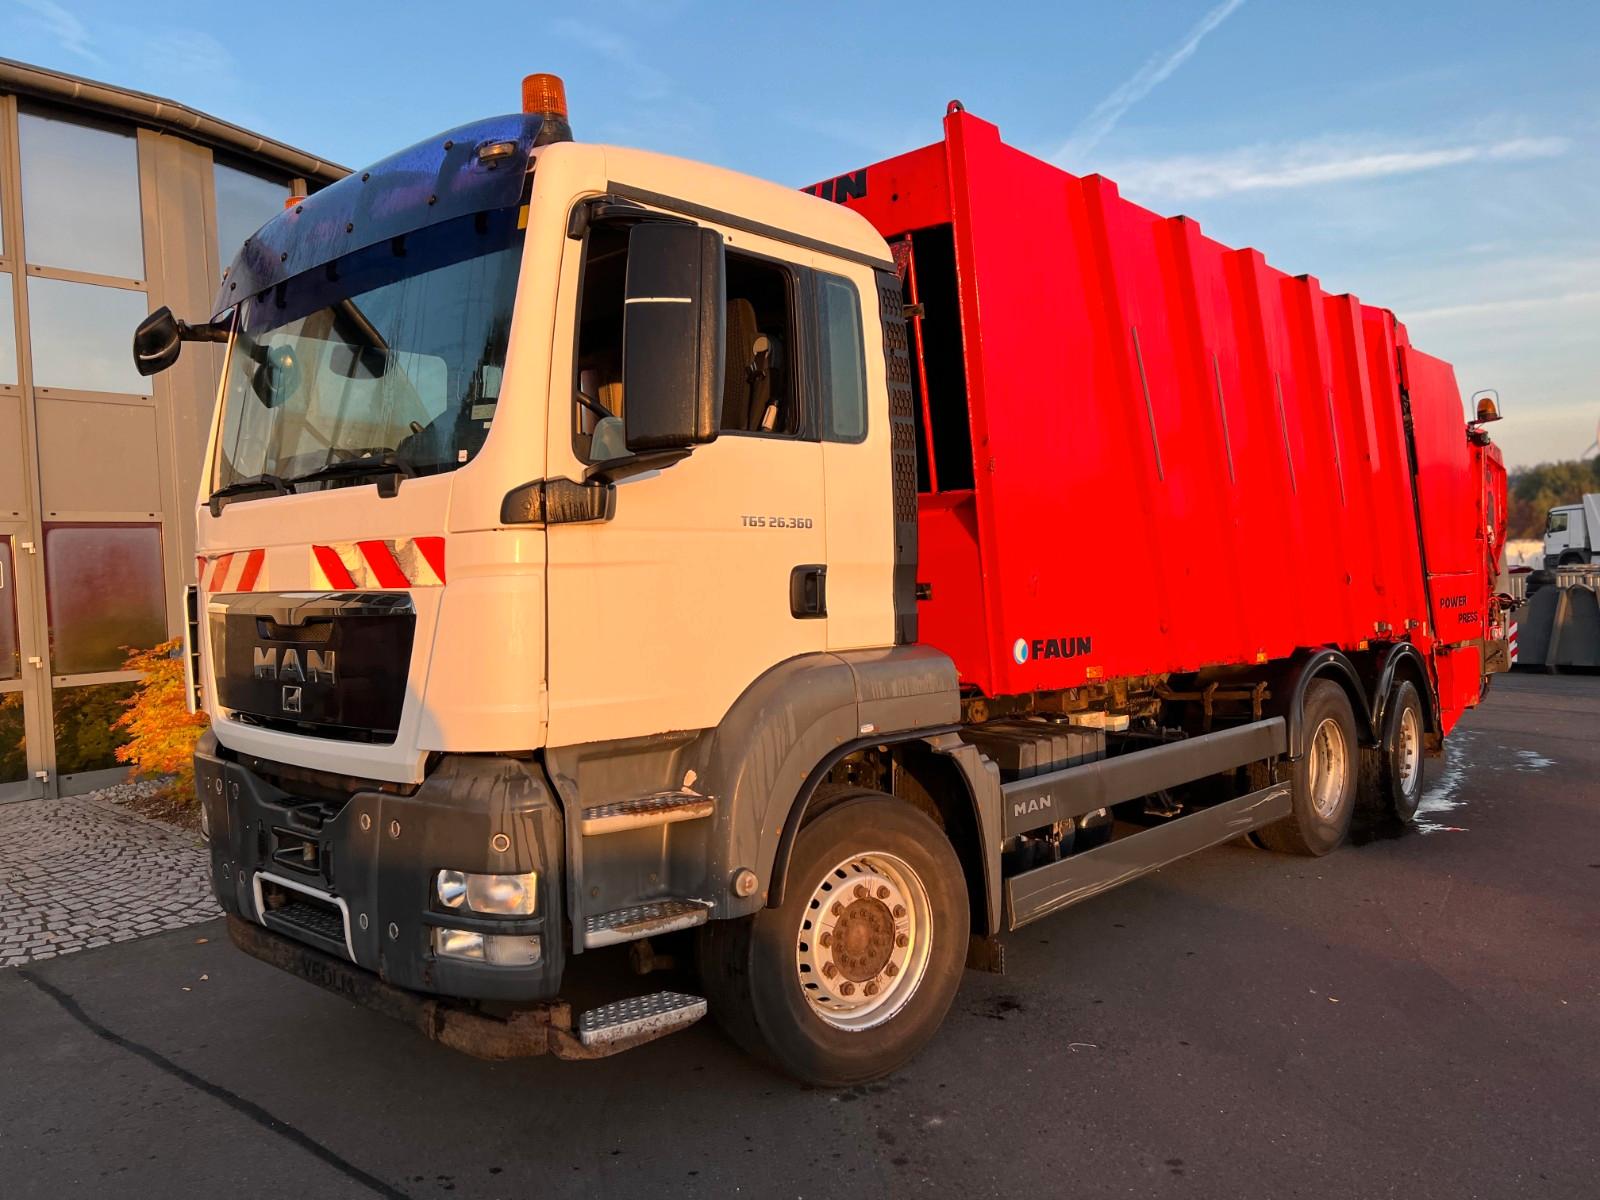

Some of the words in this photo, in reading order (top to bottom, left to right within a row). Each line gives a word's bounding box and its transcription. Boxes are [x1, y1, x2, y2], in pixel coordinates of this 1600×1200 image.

[741, 516, 766, 527] TGS
[769, 517, 813, 529] 26.360
[1440, 596, 1467, 608] POWER
[1458, 611, 1478, 623] PRESS
[1032, 636, 1091, 660] FAUN
[254, 646, 336, 684] MAN
[1014, 795, 1051, 817] MAN
